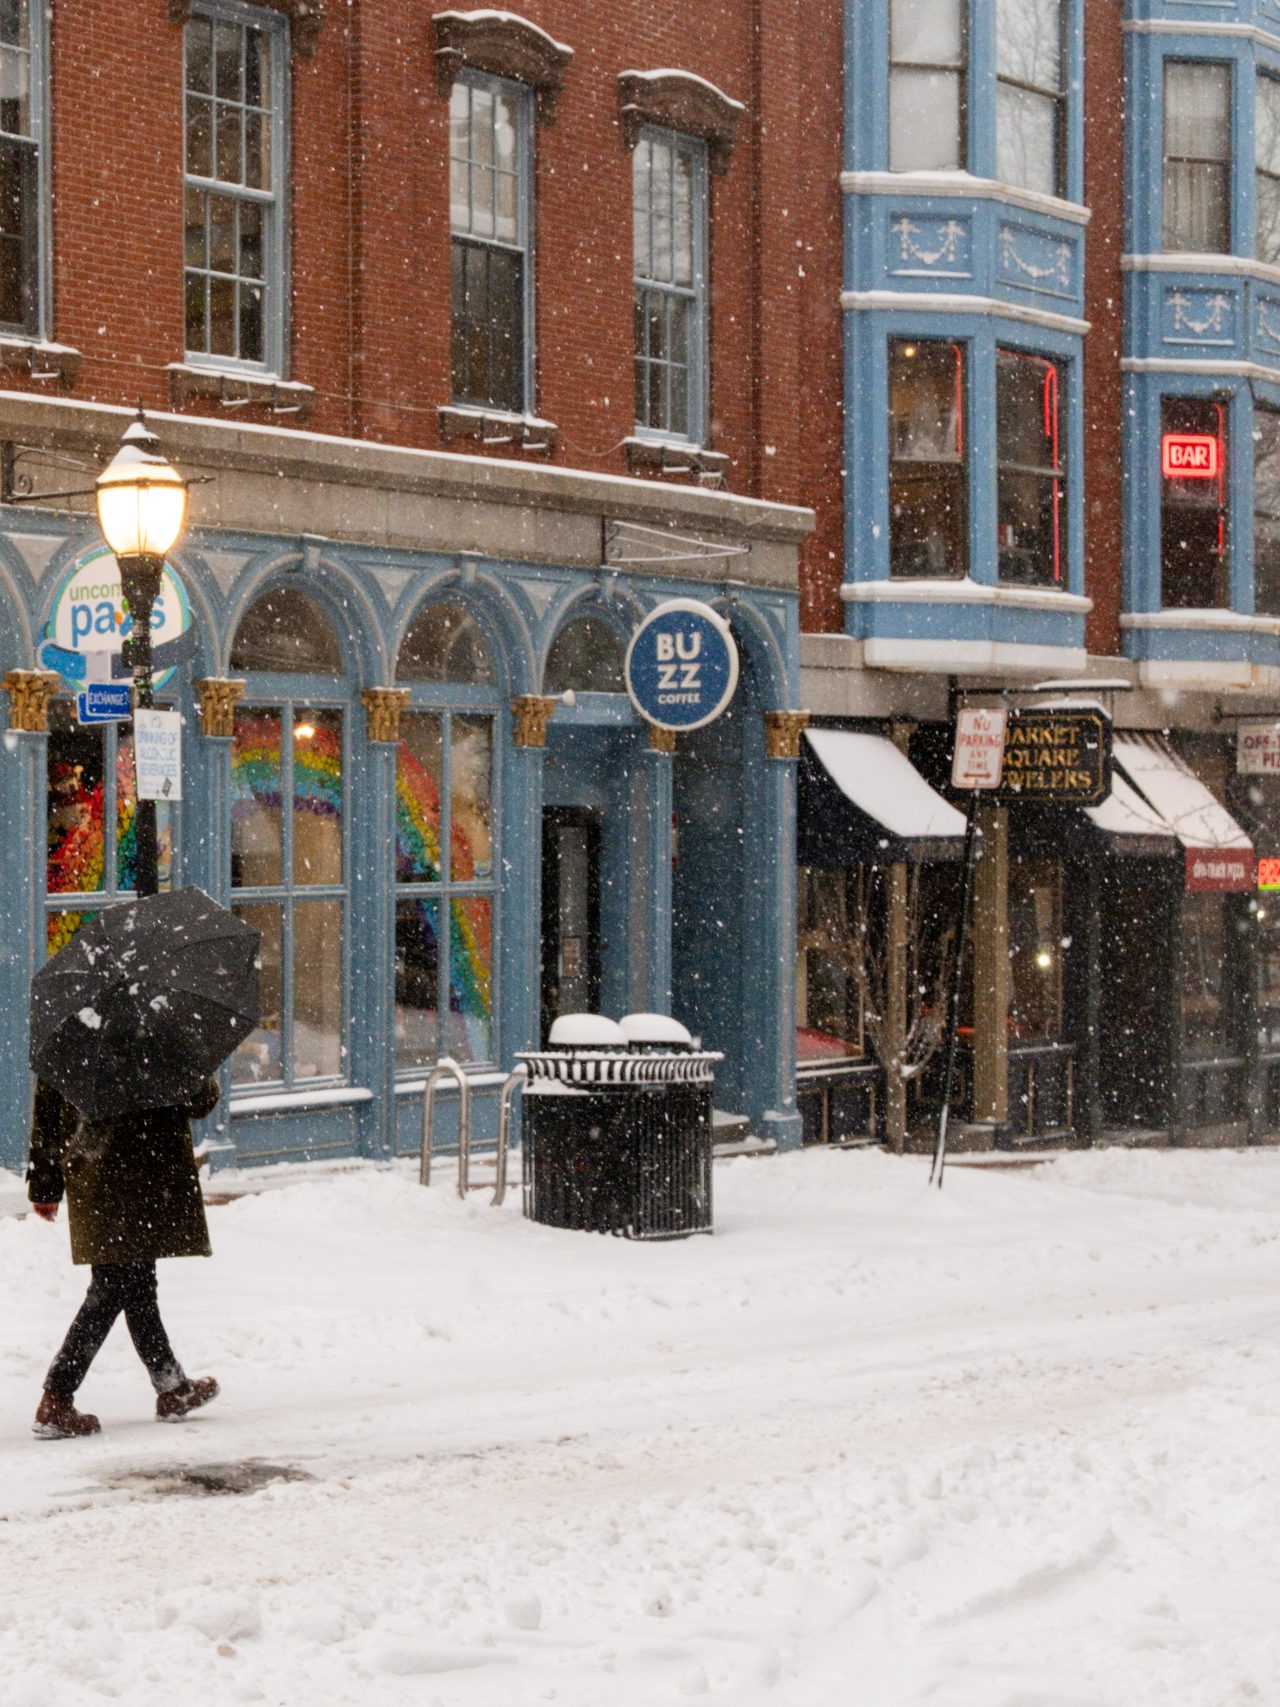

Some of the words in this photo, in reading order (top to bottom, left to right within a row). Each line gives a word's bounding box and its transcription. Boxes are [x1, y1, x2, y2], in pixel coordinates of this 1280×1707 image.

[1170, 445, 1208, 467] BAR
[657, 631, 701, 661] BU
[658, 663, 701, 689] ZZ
[90, 692, 122, 705] EXCHANGE
[658, 693, 701, 704] COFFEE
[959, 733, 1001, 747] PARKING
[970, 751, 988, 759] ANY
